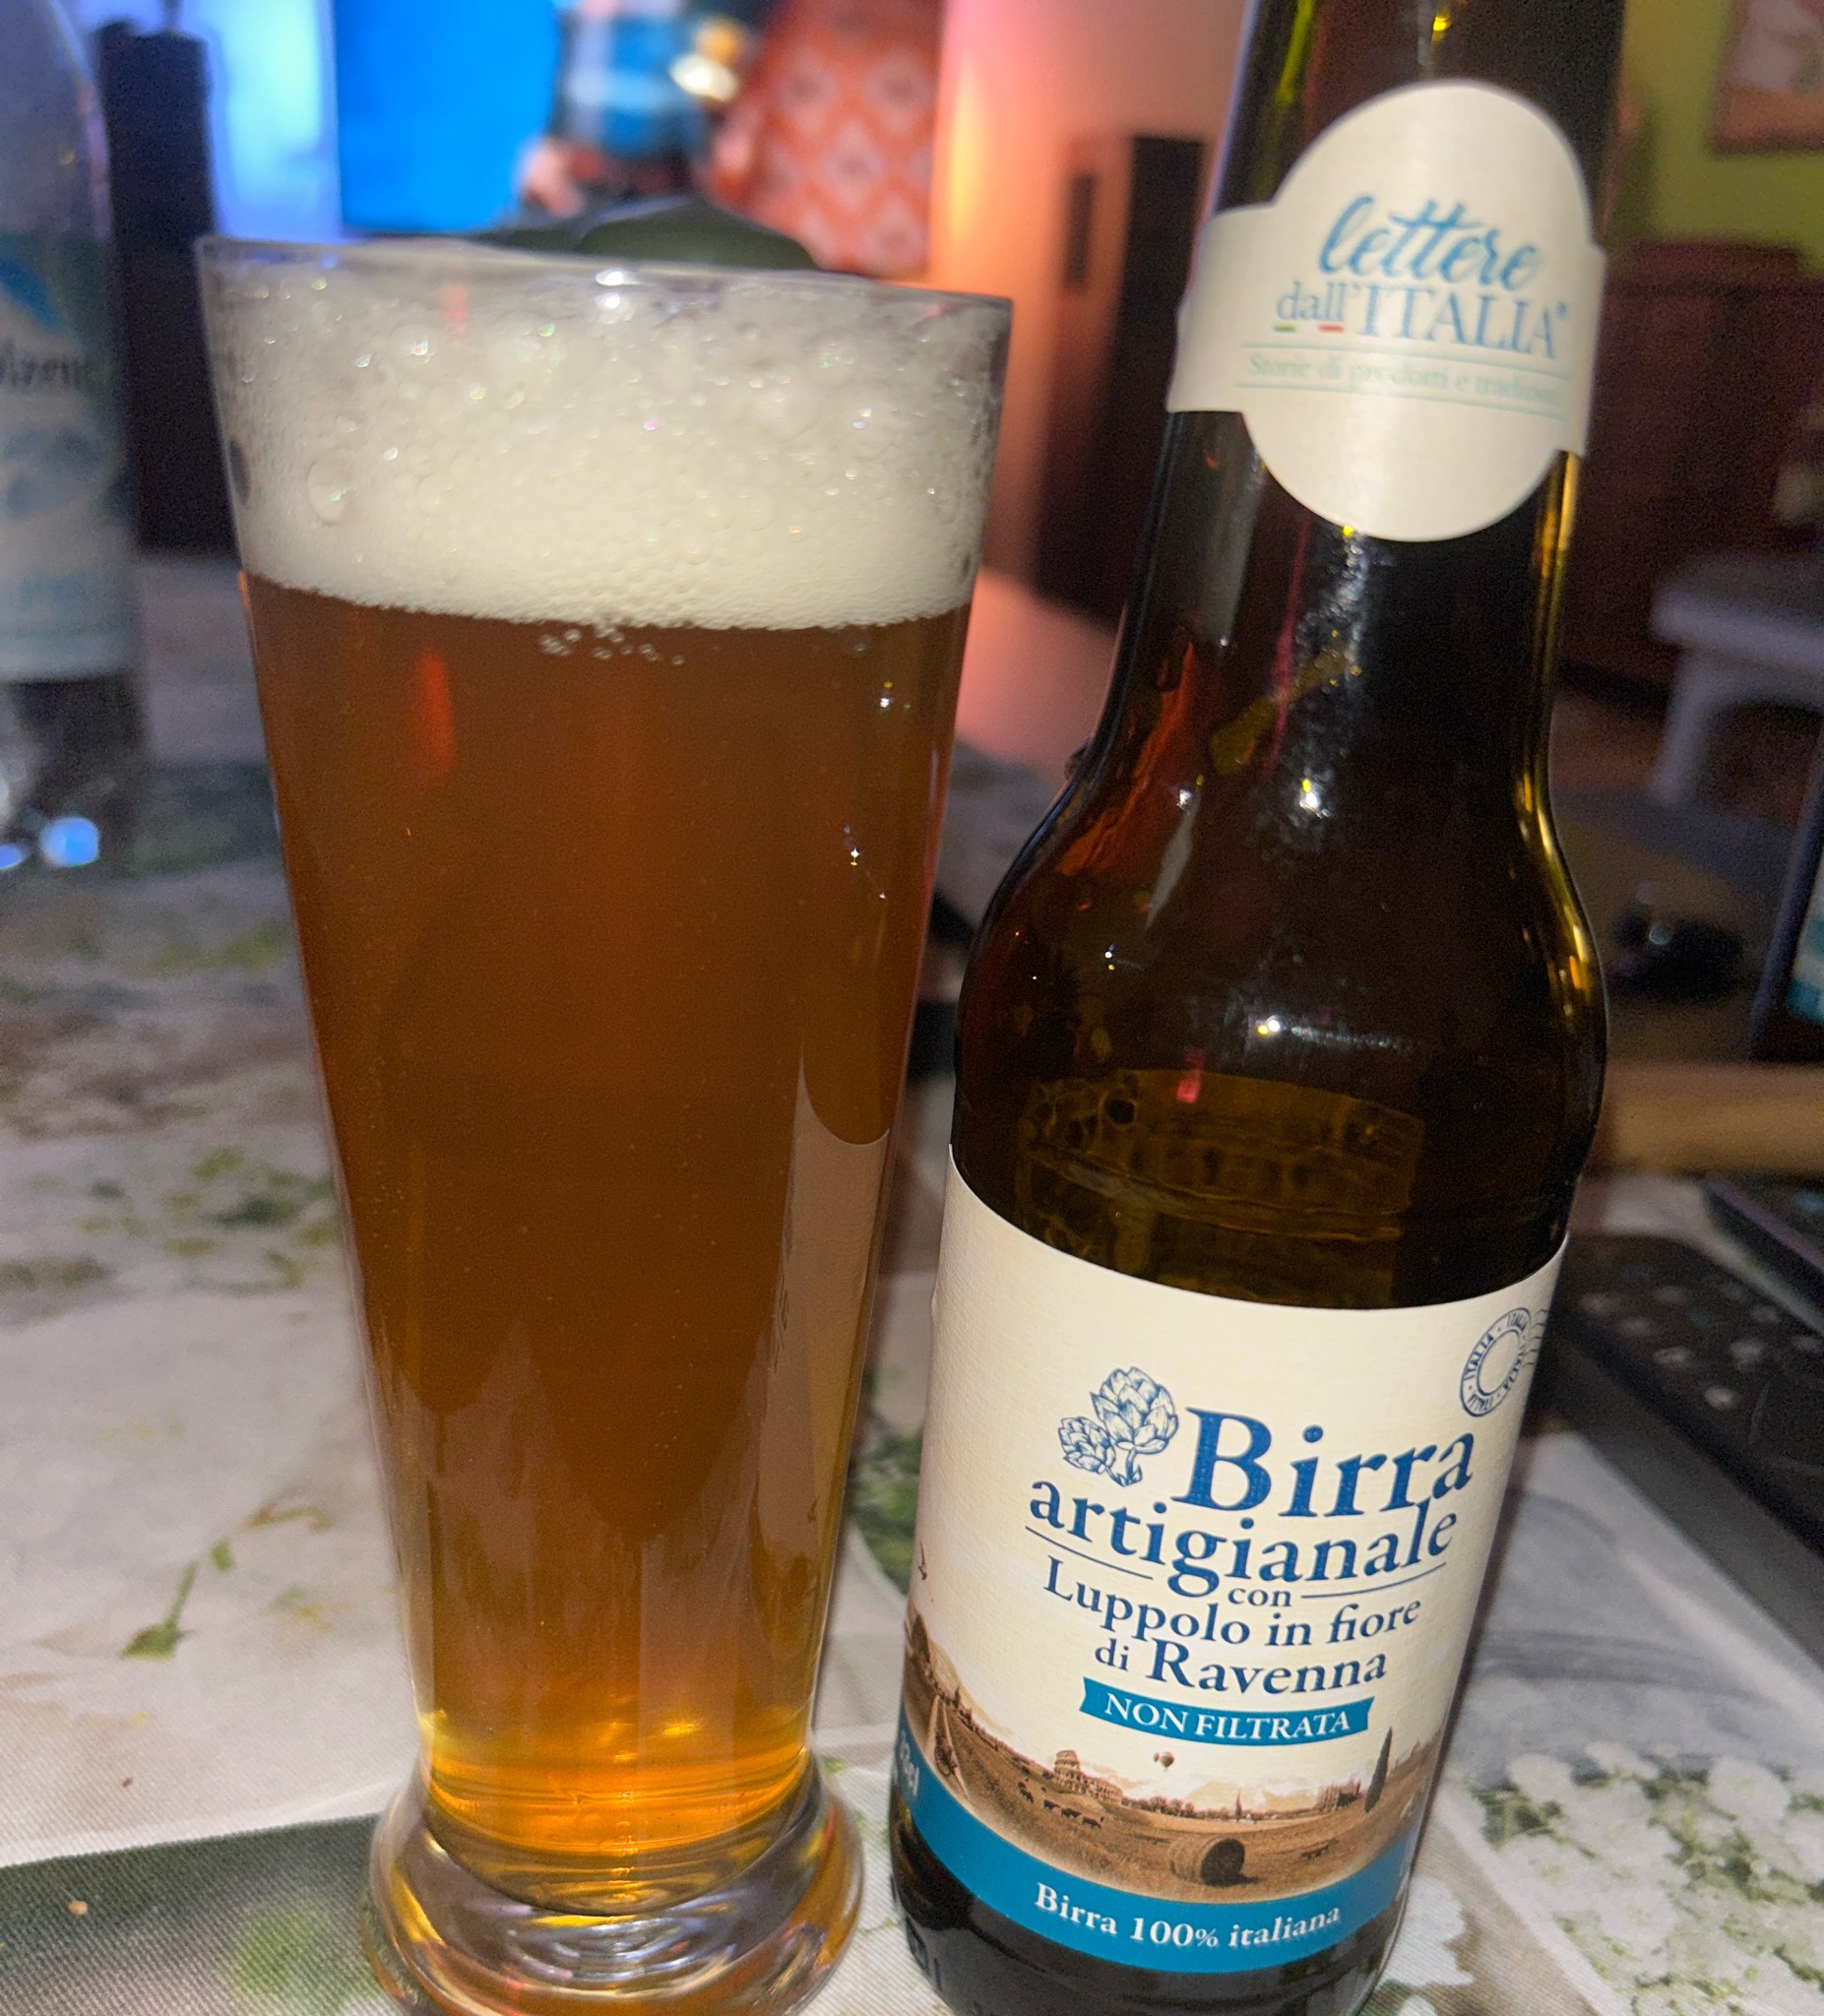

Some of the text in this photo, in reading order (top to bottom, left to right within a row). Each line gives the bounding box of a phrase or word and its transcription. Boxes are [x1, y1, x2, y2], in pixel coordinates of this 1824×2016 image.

[1318, 193, 1542, 292] lettere
[1319, 355, 1341, 380] di
[1464, 1333, 1494, 1381] ITALIA
[1169, 1406, 1475, 1517] Birra
[1030, 1480, 1457, 1598] artigianale
[1043, 1554, 1421, 1646] Luppolo in fiore
[1227, 1588, 1291, 1607] con
[1095, 1638, 1387, 1695] di Ravenna
[1103, 1692, 1351, 1741] NON FILTRATA
[1035, 1881, 1342, 1949] Birra 100% italiana
